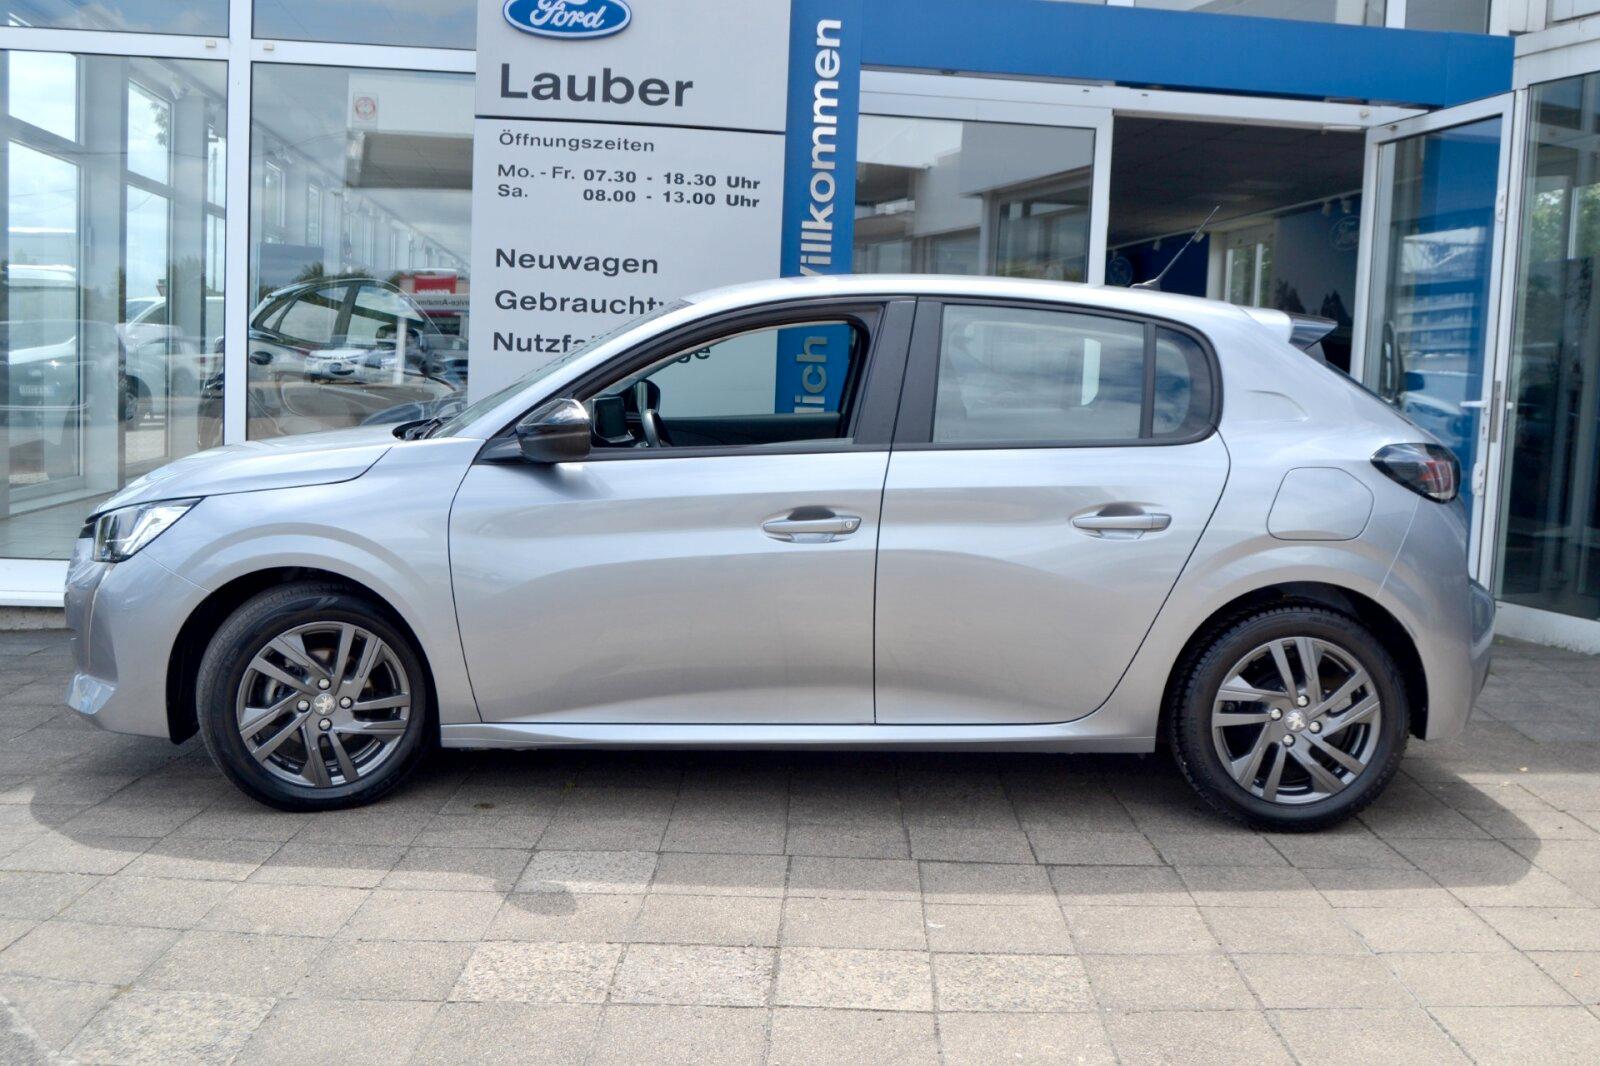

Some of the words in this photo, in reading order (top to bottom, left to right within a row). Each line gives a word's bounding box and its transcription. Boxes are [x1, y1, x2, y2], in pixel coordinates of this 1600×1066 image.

[529, 0, 607, 28] Ford
[500, 63, 693, 107] Lauber
[499, 129, 655, 152] Öffnungszeiten
[800, 19, 842, 276] illkommen
[497, 164, 535, 178] Mo.
[552, 166, 575, 180] Fr.
[583, 169, 637, 183] 07.30
[663, 172, 717, 187] 18.30
[726, 175, 761, 189] Uhr
[497, 184, 528, 198] Sa.
[583, 189, 636, 203] 08.00
[663, 190, 716, 205] 13.00
[726, 193, 760, 208] Uhr
[495, 248, 658, 277] Neuwagen
[494, 289, 664, 315] Gebraucht
